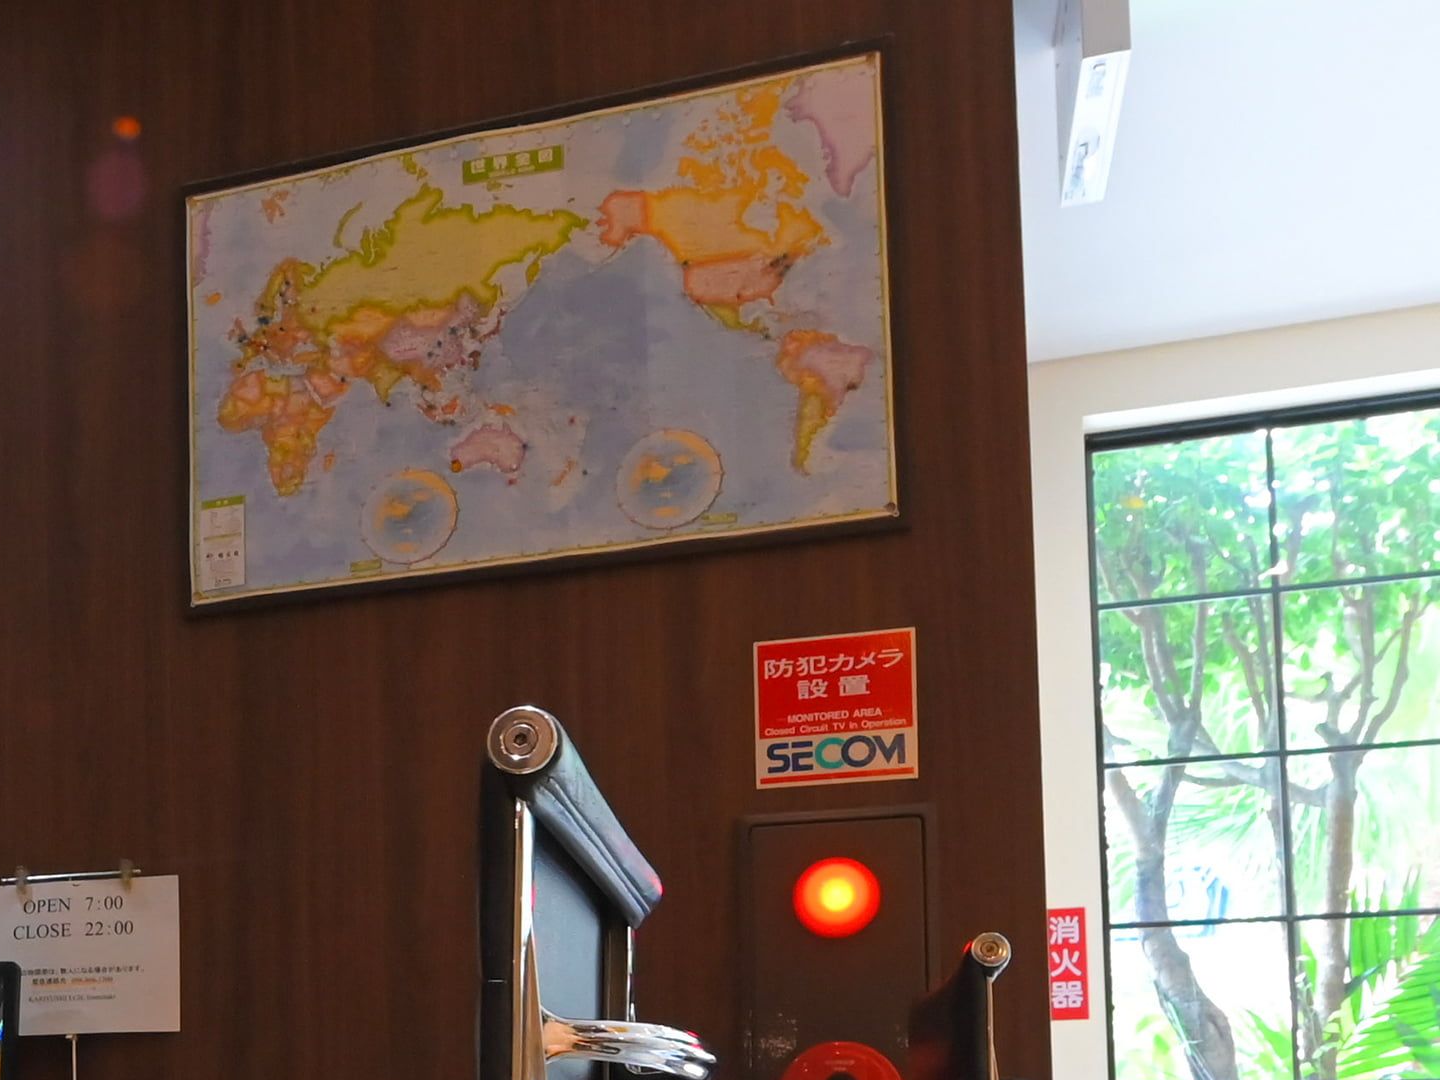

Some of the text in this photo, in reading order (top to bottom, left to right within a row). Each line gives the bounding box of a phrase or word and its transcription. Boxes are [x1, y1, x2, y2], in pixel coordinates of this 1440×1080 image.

[764, 648, 904, 679] 防犯カメラ
[797, 675, 871, 700] 設置
[764, 726, 796, 737] Closed
[799, 724, 830, 734] Circuit
[833, 722, 846, 731] TV
[861, 717, 907, 729] Operation
[787, 708, 882, 724] MONITORED AREA
[766, 733, 907, 774] SECOM
[23, 895, 124, 915] OPEN 7:00
[13, 920, 134, 941] CLOSE 22:00
[1049, 915, 1084, 1009] 消火器
